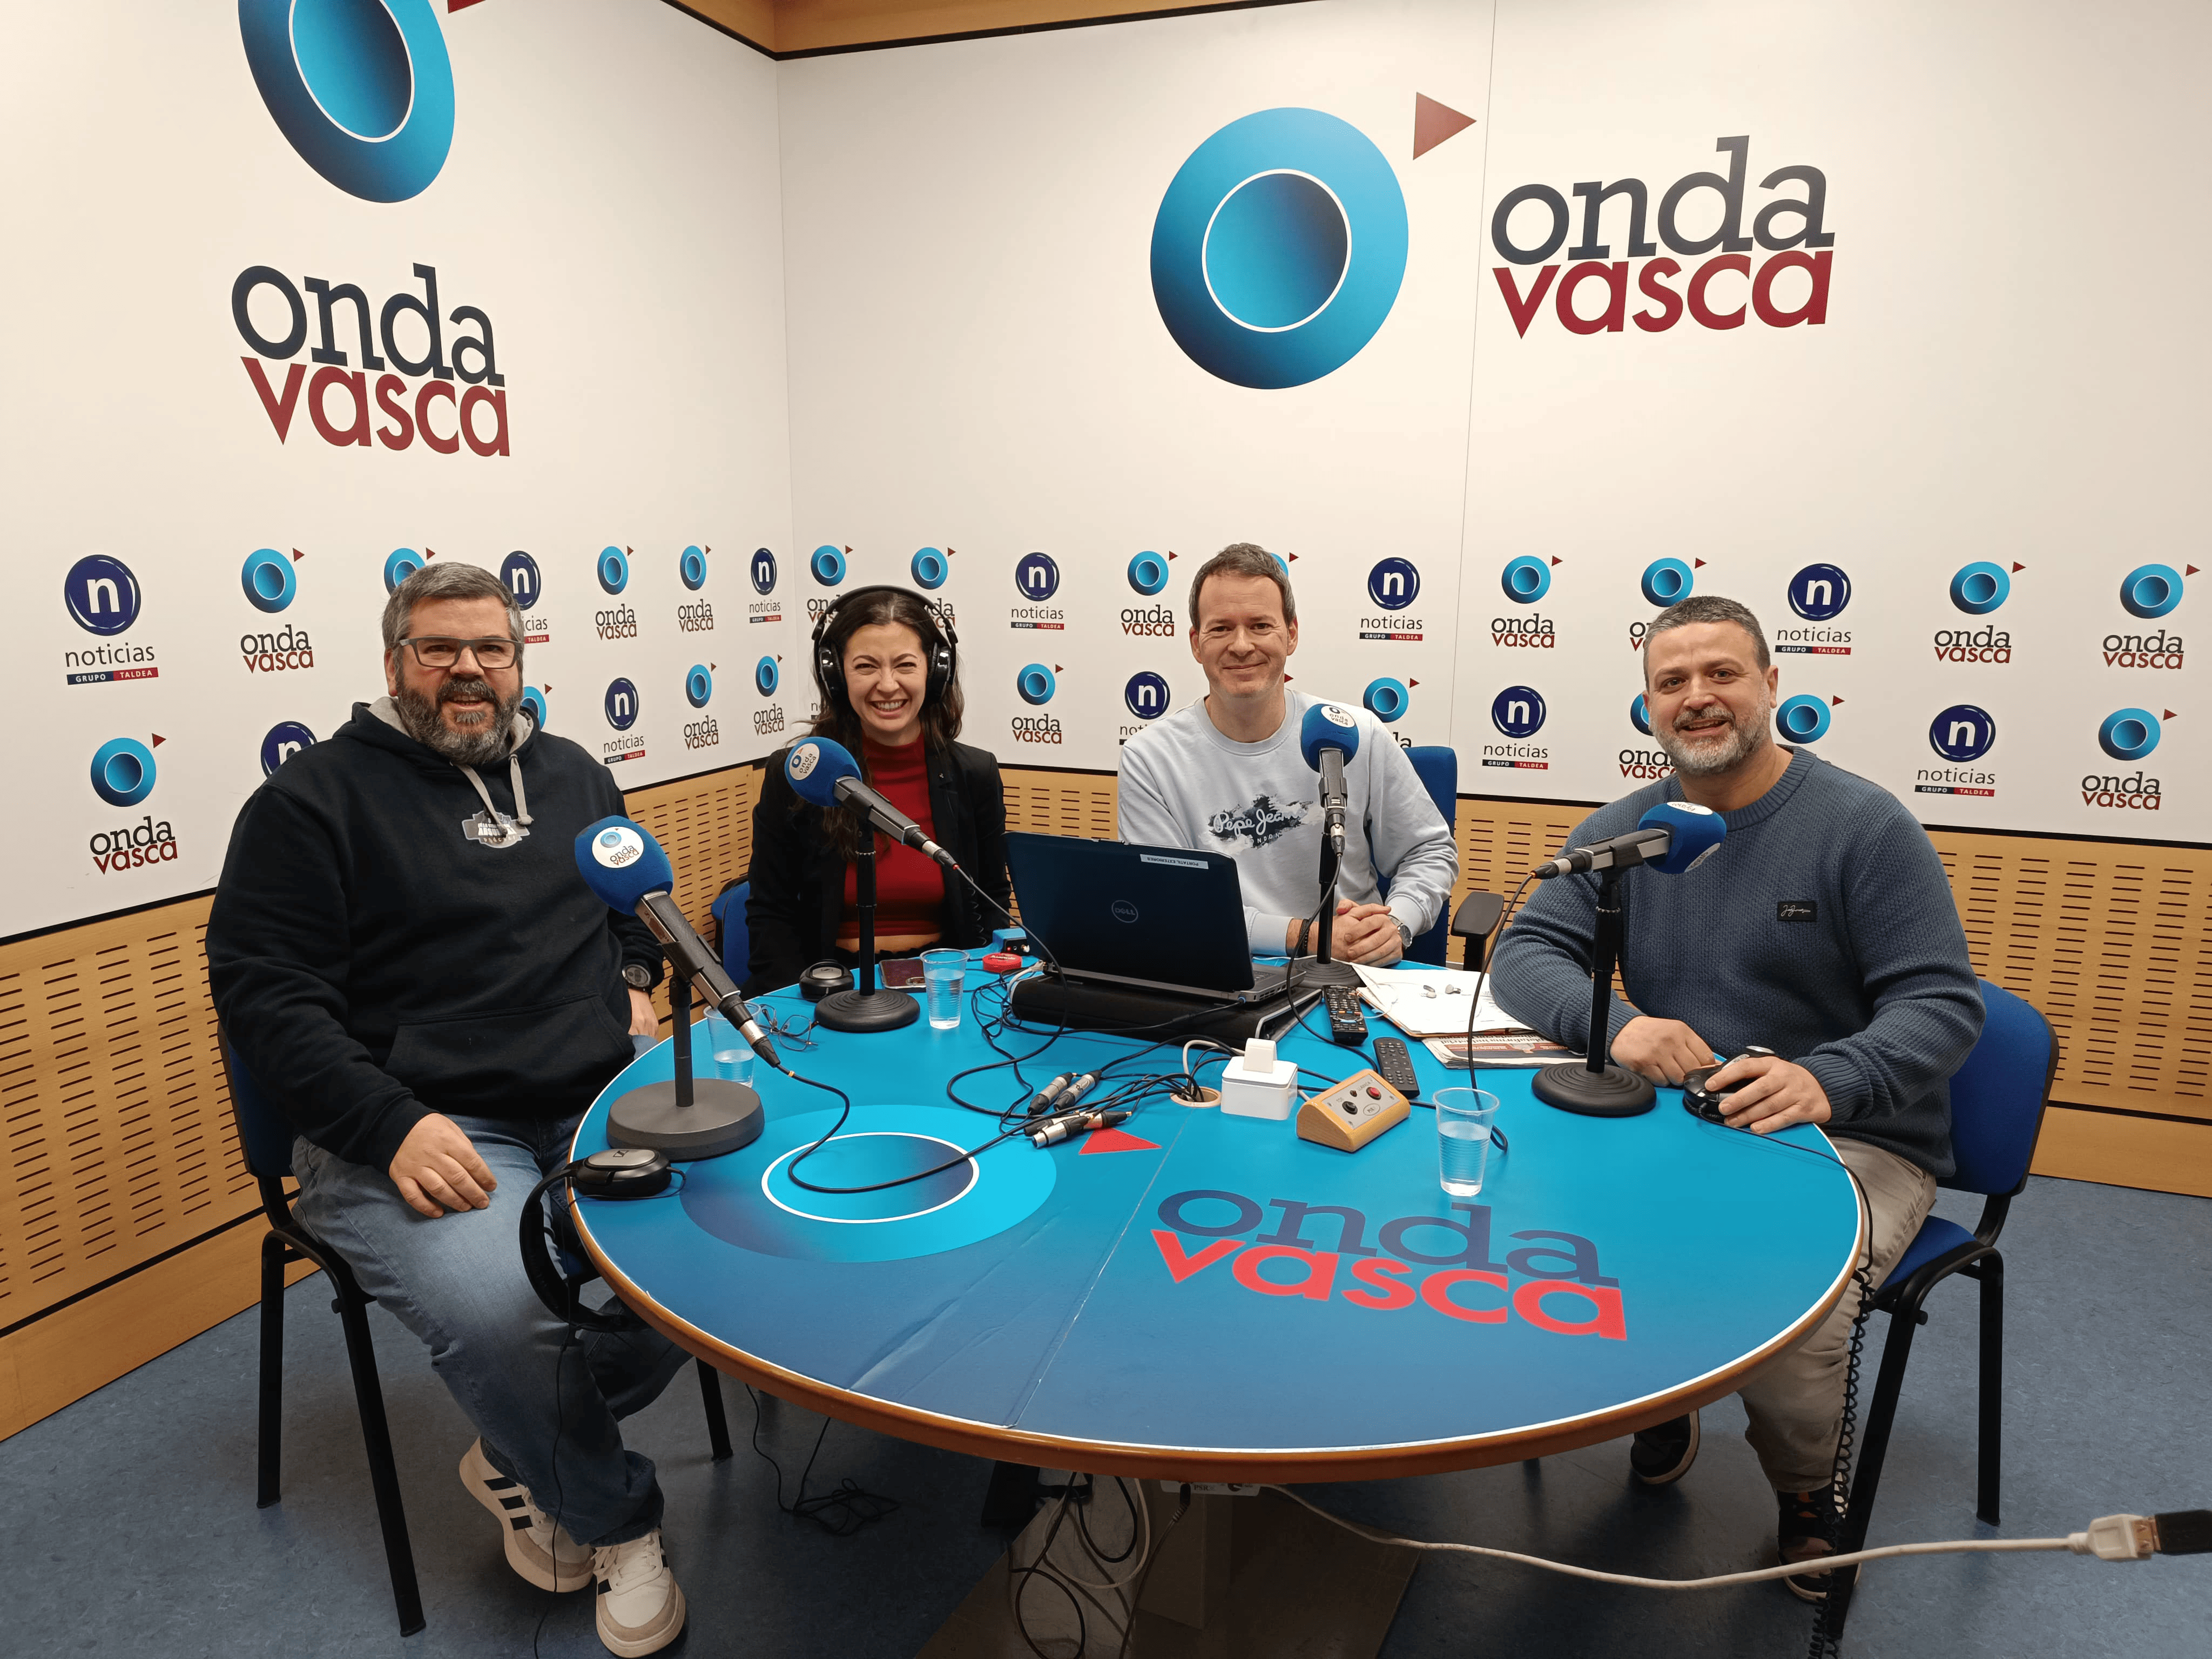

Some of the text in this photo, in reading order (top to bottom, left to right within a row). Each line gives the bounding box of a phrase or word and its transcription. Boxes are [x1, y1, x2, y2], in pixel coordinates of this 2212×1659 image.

[1492, 135, 1835, 265] onda
[1492, 250, 1833, 340] vasca
[232, 262, 505, 387] onda
[240, 356, 510, 457] vasca
[596, 603, 636, 626] onda
[678, 598, 713, 619] onda
[750, 599, 781, 613] noticias
[1011, 606, 1063, 619] noticias
[1121, 604, 1174, 624] onda
[522, 615, 548, 631] cias
[597, 625, 637, 640] vasca
[679, 617, 713, 633] vasca
[1121, 622, 1175, 636] vasca
[1361, 615, 1422, 630] noticias
[1491, 613, 1555, 634] onda
[241, 624, 312, 655] onda
[1492, 632, 1555, 648] vasca
[1777, 626, 1851, 642] noticias
[1934, 625, 2012, 649] onda
[2102, 629, 2184, 654] onda
[65, 643, 155, 667] noticias
[242, 650, 314, 673] vasca
[1935, 646, 2011, 664] vasca
[2102, 651, 2183, 670] vasca
[76, 670, 152, 683] GRUPO TALDEA
[754, 703, 784, 725] onda
[1011, 714, 1062, 732] onda
[1330, 713, 1348, 723] onda
[684, 715, 718, 738] onda
[754, 718, 785, 736] vasca
[1013, 729, 1062, 744] vasca
[604, 734, 644, 753] noticias
[685, 731, 719, 751] vasca
[1484, 743, 1548, 758] noticias
[799, 753, 813, 773] onda
[803, 756, 817, 773] vasca
[1918, 768, 1995, 785] noticias
[2081, 771, 2161, 795] onda
[2082, 791, 2161, 811] vasca
[1213, 812, 1255, 837] Pepe
[90, 815, 175, 855] onda
[92, 840, 178, 875] vasca
[610, 845, 635, 862] onda
[613, 848, 639, 865] vasca
[1115, 907, 1136, 915] DELL
[1157, 1190, 1619, 1287] onda
[1150, 1229, 1627, 1341] vasca
